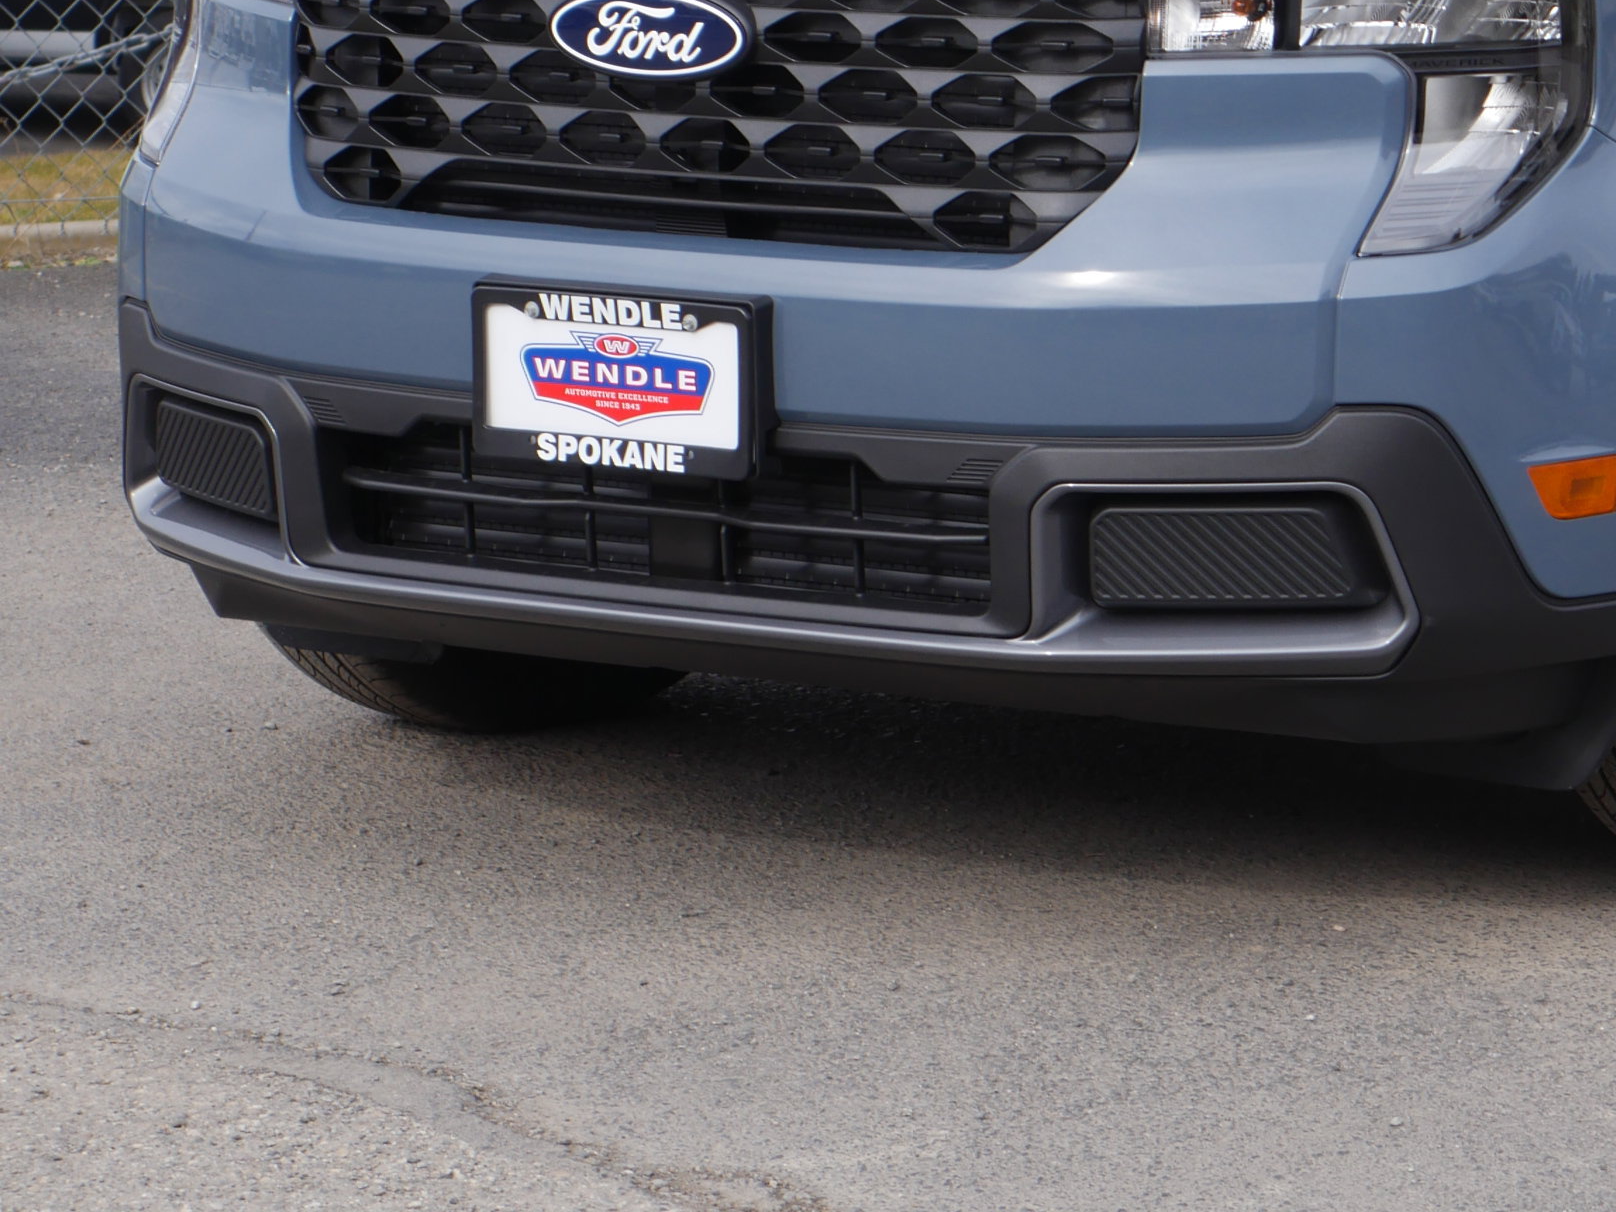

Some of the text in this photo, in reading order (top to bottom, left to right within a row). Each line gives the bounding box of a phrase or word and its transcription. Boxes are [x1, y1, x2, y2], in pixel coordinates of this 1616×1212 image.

[586, 0, 705, 64] Ford
[1408, 57, 1505, 69] MAVERICK
[538, 292, 684, 330] WENDLE
[603, 339, 631, 355] W
[532, 356, 697, 391] WENDLE
[564, 387, 669, 404] AUTOMOTIVE EXCELLENCE
[595, 399, 620, 409] SINCE
[536, 432, 686, 474] SPOKANE
